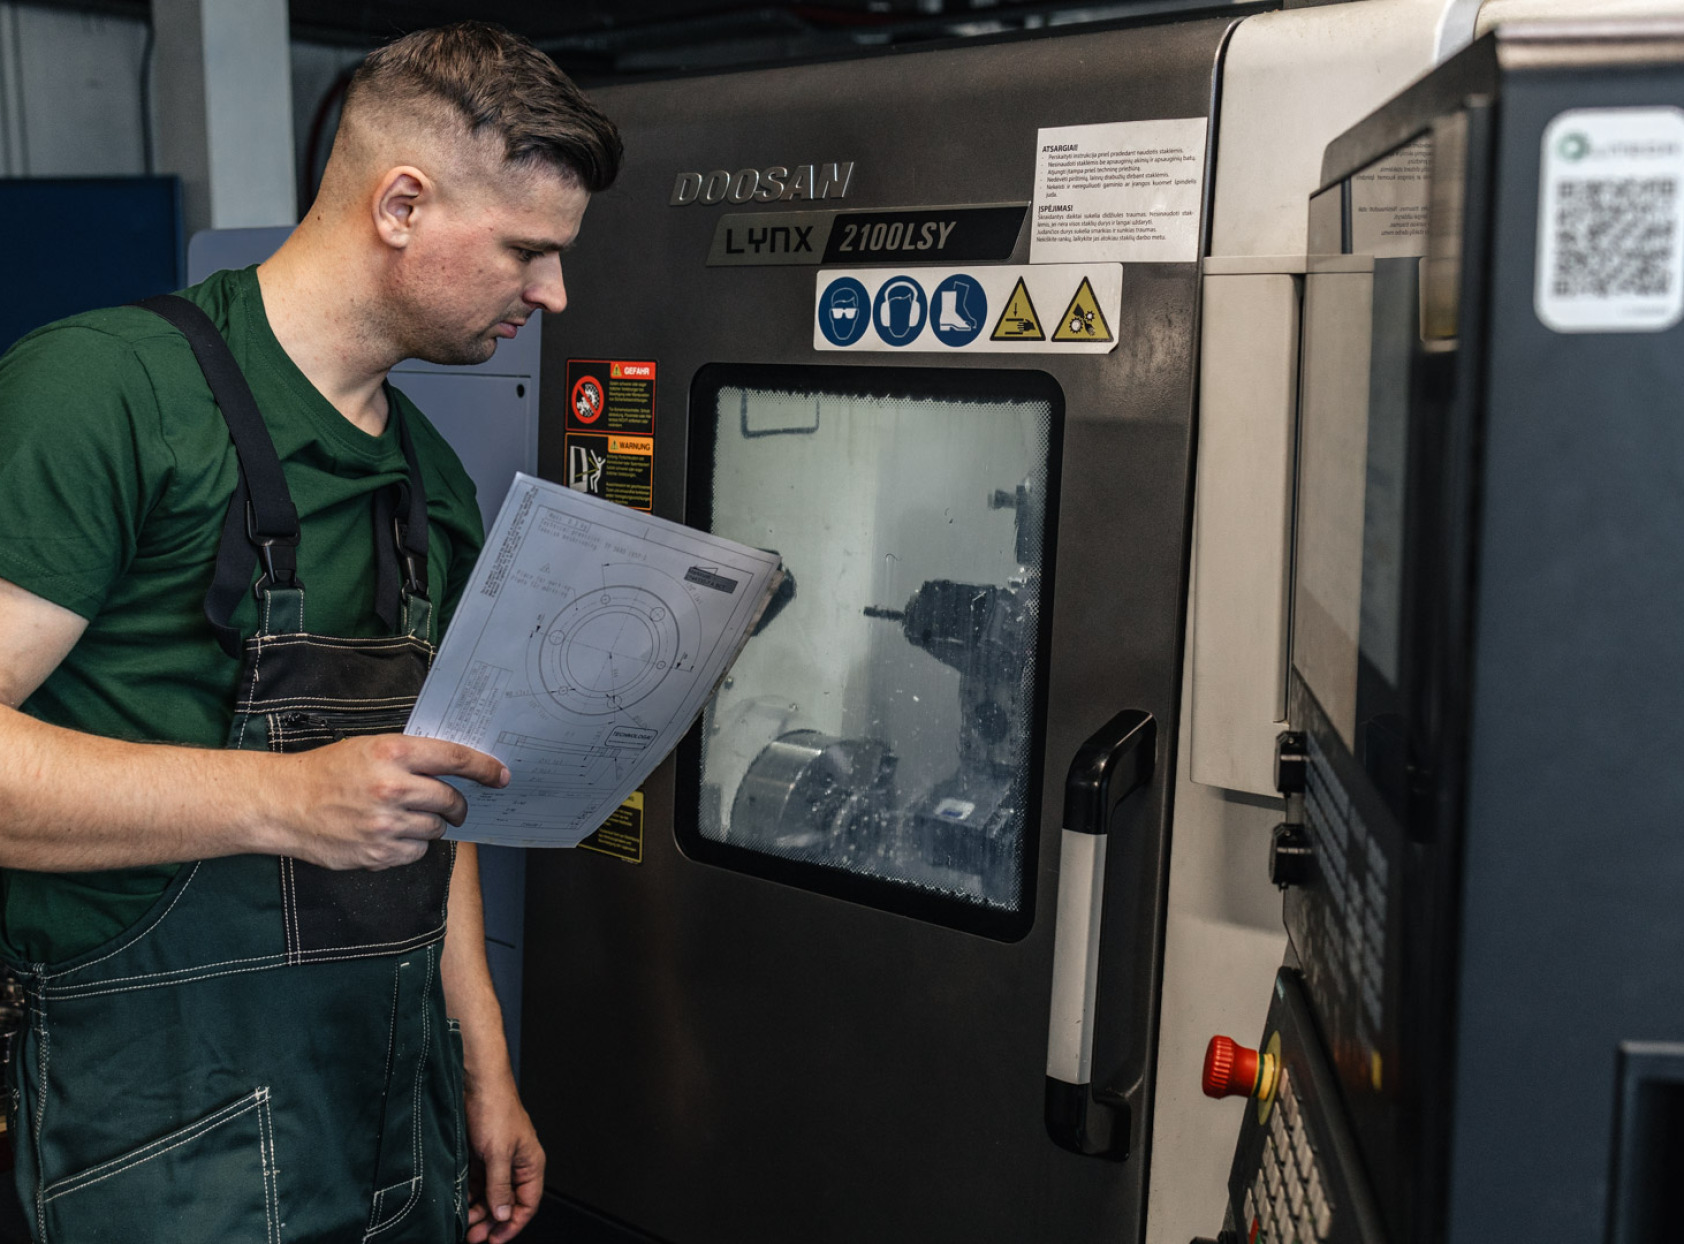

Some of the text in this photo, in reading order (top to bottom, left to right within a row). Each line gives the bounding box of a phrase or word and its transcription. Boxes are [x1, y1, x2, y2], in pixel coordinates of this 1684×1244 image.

[669, 161, 854, 206] DOOSAN
[725, 221, 957, 254] LYNX 2100LSY
[624, 366, 650, 376] GEFAHR
[619, 441, 651, 451] WARNUNG
